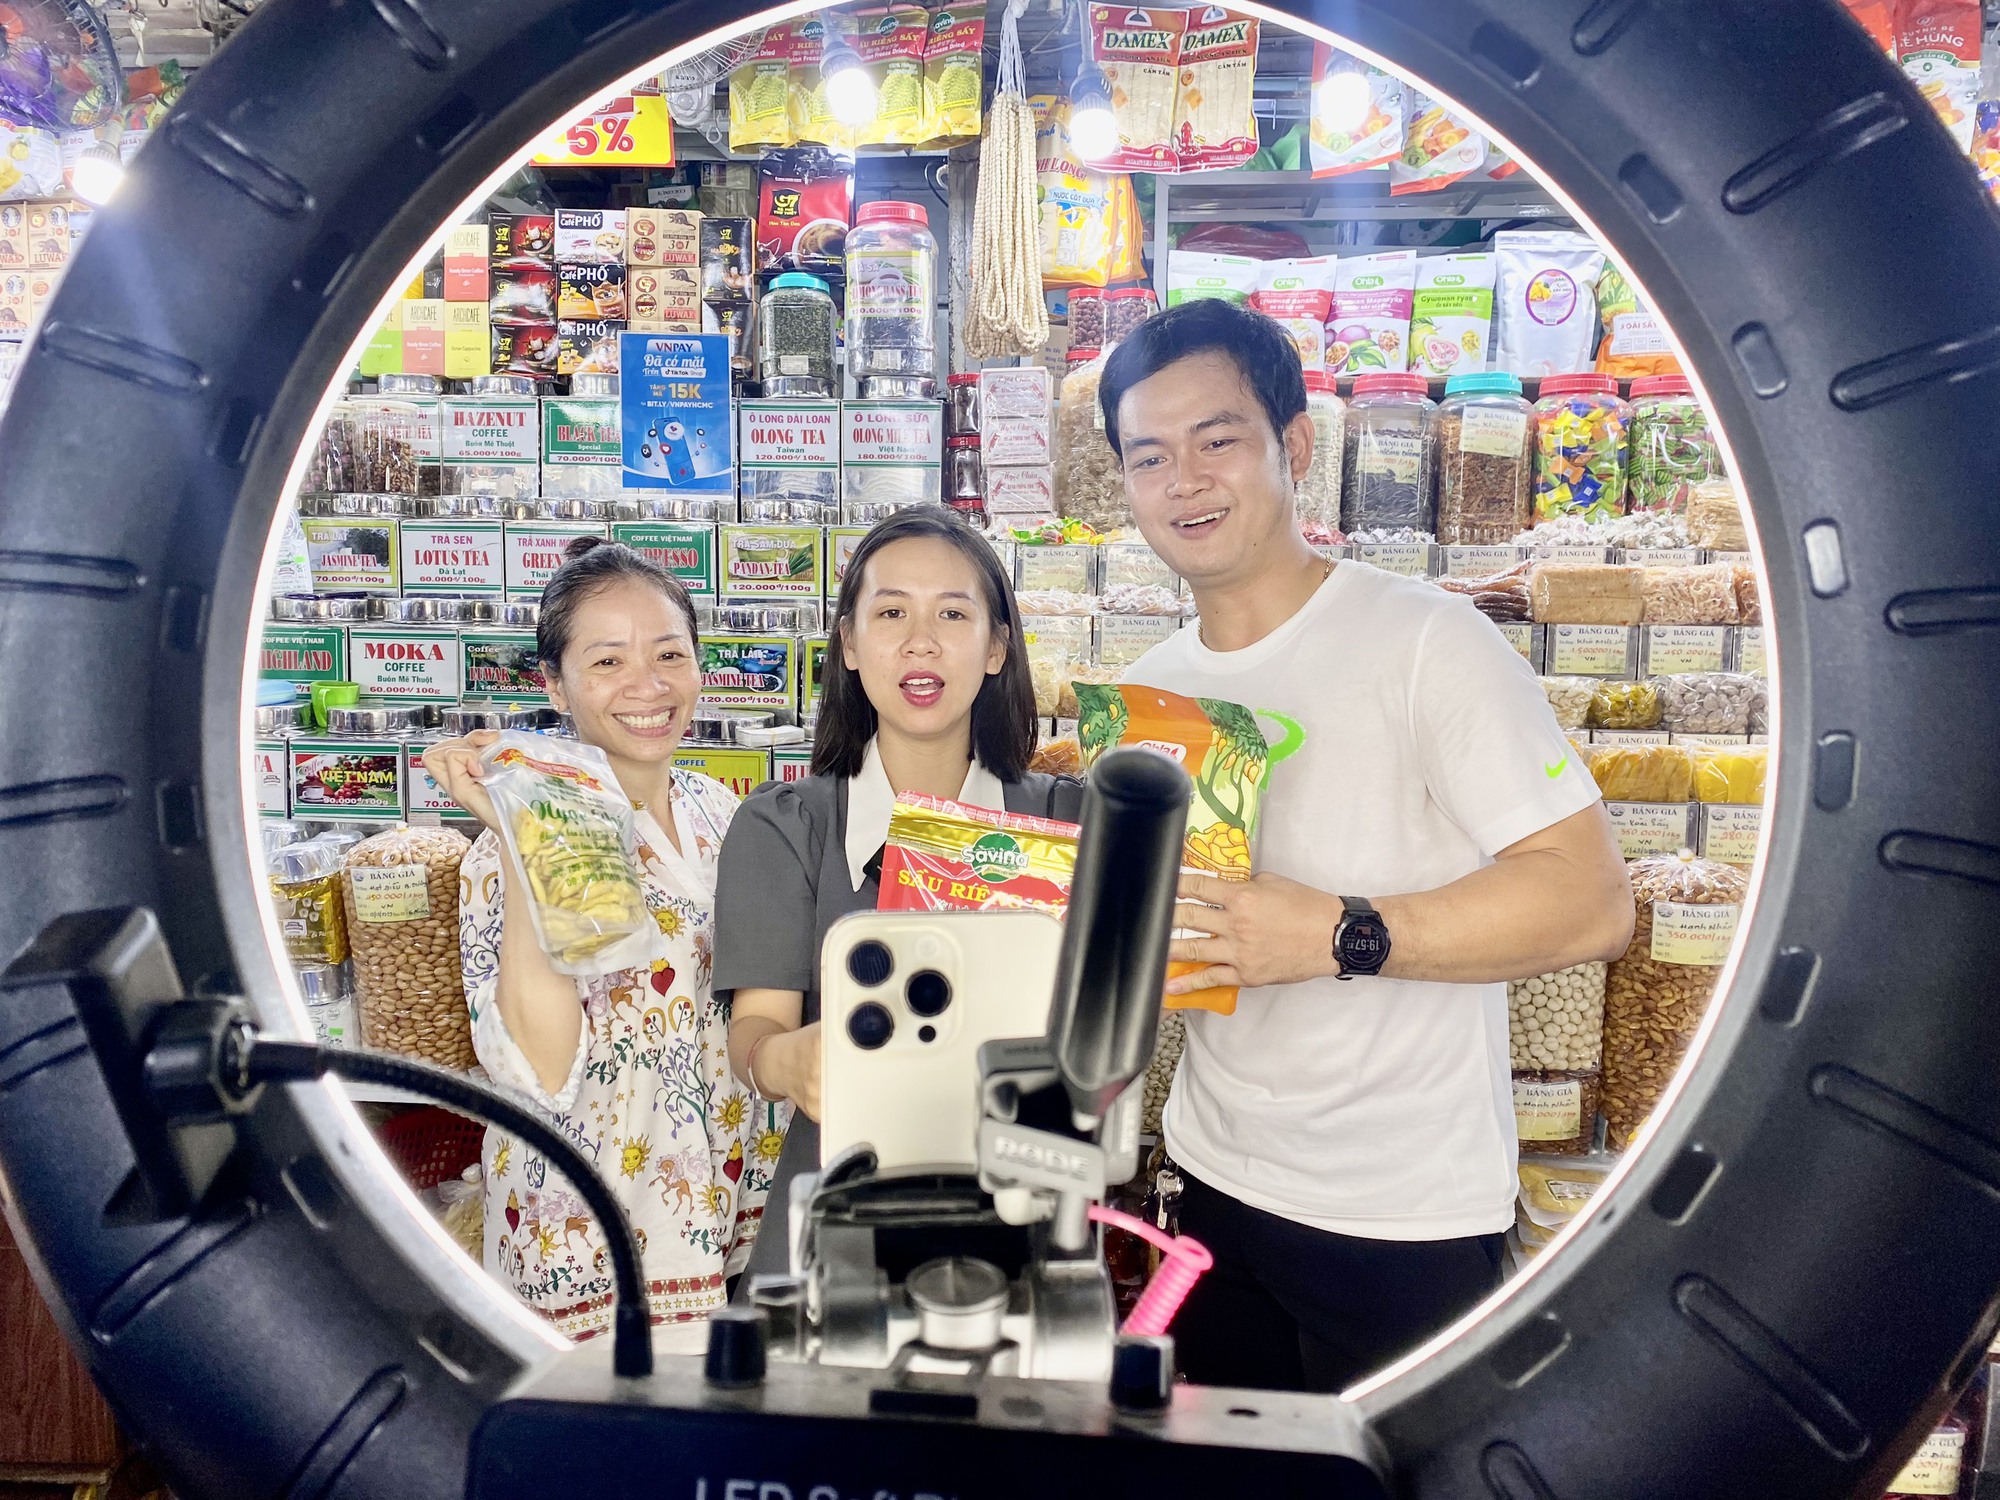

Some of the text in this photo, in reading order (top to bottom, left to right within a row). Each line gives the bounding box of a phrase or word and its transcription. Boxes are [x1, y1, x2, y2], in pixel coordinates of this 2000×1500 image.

[1104, 32, 1171, 49] DAMEX
[1182, 22, 1246, 51] DAMEX
[1915, 32, 1964, 47] HÙNG
[1051, 157, 1087, 181] LONG
[560, 217, 575, 227] Café
[575, 213, 602, 227] PHỐ
[664, 253, 696, 263] LUWAK
[560, 264, 609, 280] Café PHỐ
[665, 310, 696, 320] LUWAK
[577, 319, 608, 336] PHỐ
[655, 342, 693, 352] VNPAY
[643, 353, 704, 369] Đã có mặt
[668, 383, 701, 399] 15K
[453, 411, 526, 427] HAZENUT
[749, 412, 831, 424] Ô LONG ĐÀI LOAN
[854, 412, 863, 423] Ô
[471, 428, 508, 438] COFFEE
[557, 425, 596, 442] BLACK
[751, 428, 826, 445] OLONG TEA
[852, 428, 883, 444] OLONG
[495, 440, 515, 449] Thuột
[577, 443, 601, 451] Special
[776, 446, 805, 454] Taiwan
[878, 445, 895, 453] Việt
[431, 532, 473, 545] TRÀ SEN
[517, 535, 556, 548] TRÀ XANH
[321, 553, 378, 568] JASMINE TEA
[414, 550, 490, 567] LOTUS TEA
[438, 567, 450, 576] Đà
[733, 561, 790, 575] PANDAN TEA
[1122, 617, 1161, 626] BẢNG GIÁ
[1578, 627, 1620, 636] BẢNG GIÁ
[1673, 628, 1715, 637] BẢNG GIÁ
[261, 636, 288, 644] COFFEE
[364, 642, 445, 661] MOKA
[467, 645, 501, 653] Coffee
[384, 662, 426, 673] COFFEE
[377, 674, 433, 684] Buôn Mê Thuột
[468, 666, 511, 683] LUWAK
[701, 673, 765, 688] JASMINE TEA
[1617, 735, 1661, 744] BẢNG GIÁ
[674, 758, 706, 767] COFFEE
[318, 766, 394, 786] VIỆT NAM
[1632, 806, 1678, 815] BẢNG GIÁ
[961, 846, 1030, 869] Savina
[369, 869, 416, 880] BẢNG GIÁ
[897, 869, 944, 893] SẦU
[1682, 908, 1730, 918] BẢNG GIÁ
[1355, 939, 1380, 951] 19:57
[1526, 1086, 1573, 1097] BẢNG GIÁ
